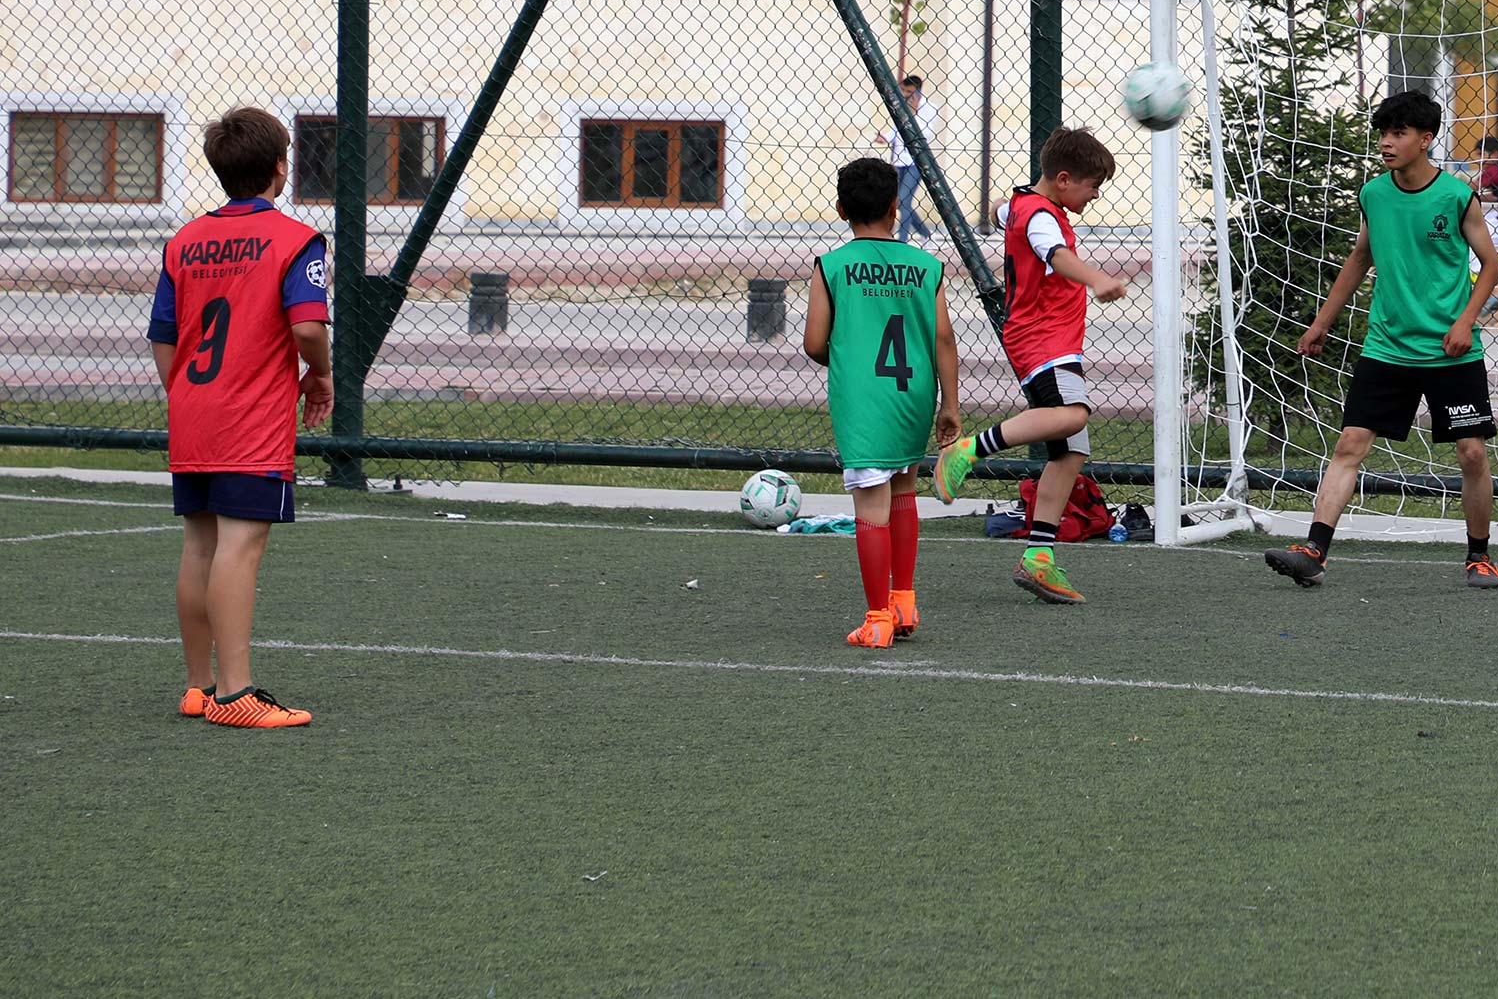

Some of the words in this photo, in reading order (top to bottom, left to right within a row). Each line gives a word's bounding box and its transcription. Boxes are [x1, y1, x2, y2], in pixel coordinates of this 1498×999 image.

[179, 237, 272, 267] KARATAY
[845, 263, 928, 289] KARATAY
[186, 296, 232, 385] 9
[875, 314, 913, 392] 4
[1448, 404, 1477, 415] NASA
